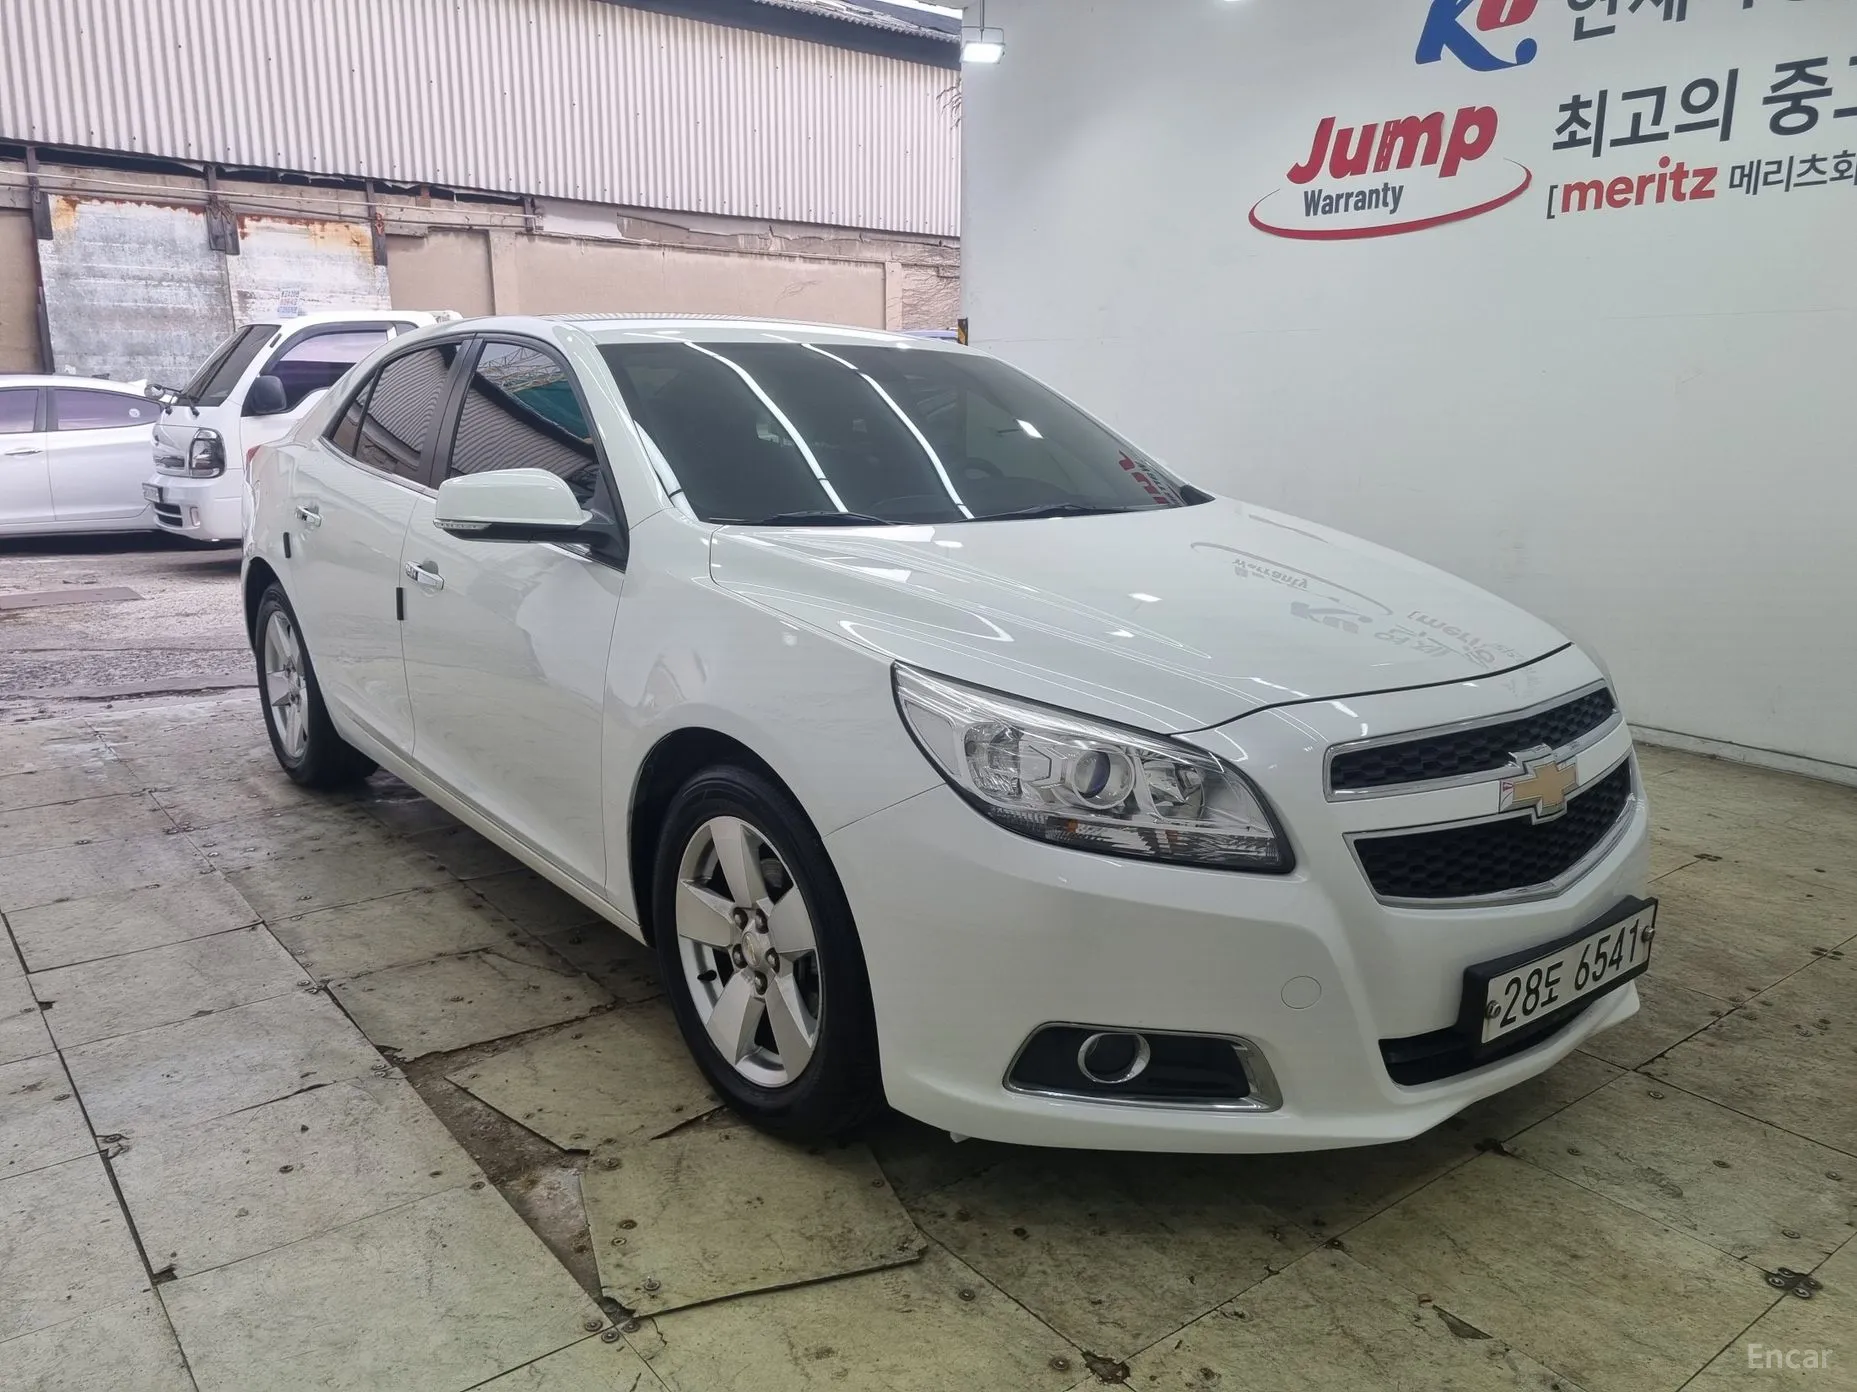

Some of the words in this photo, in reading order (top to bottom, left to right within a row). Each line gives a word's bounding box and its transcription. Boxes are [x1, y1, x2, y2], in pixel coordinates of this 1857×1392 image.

[1286, 105, 1498, 184] Jump
[1552, 68, 1740, 158] 최고의
[1303, 182, 1404, 217] Warranty
[1500, 961, 1564, 1029] 28도
[1574, 918, 1640, 991] 6541
